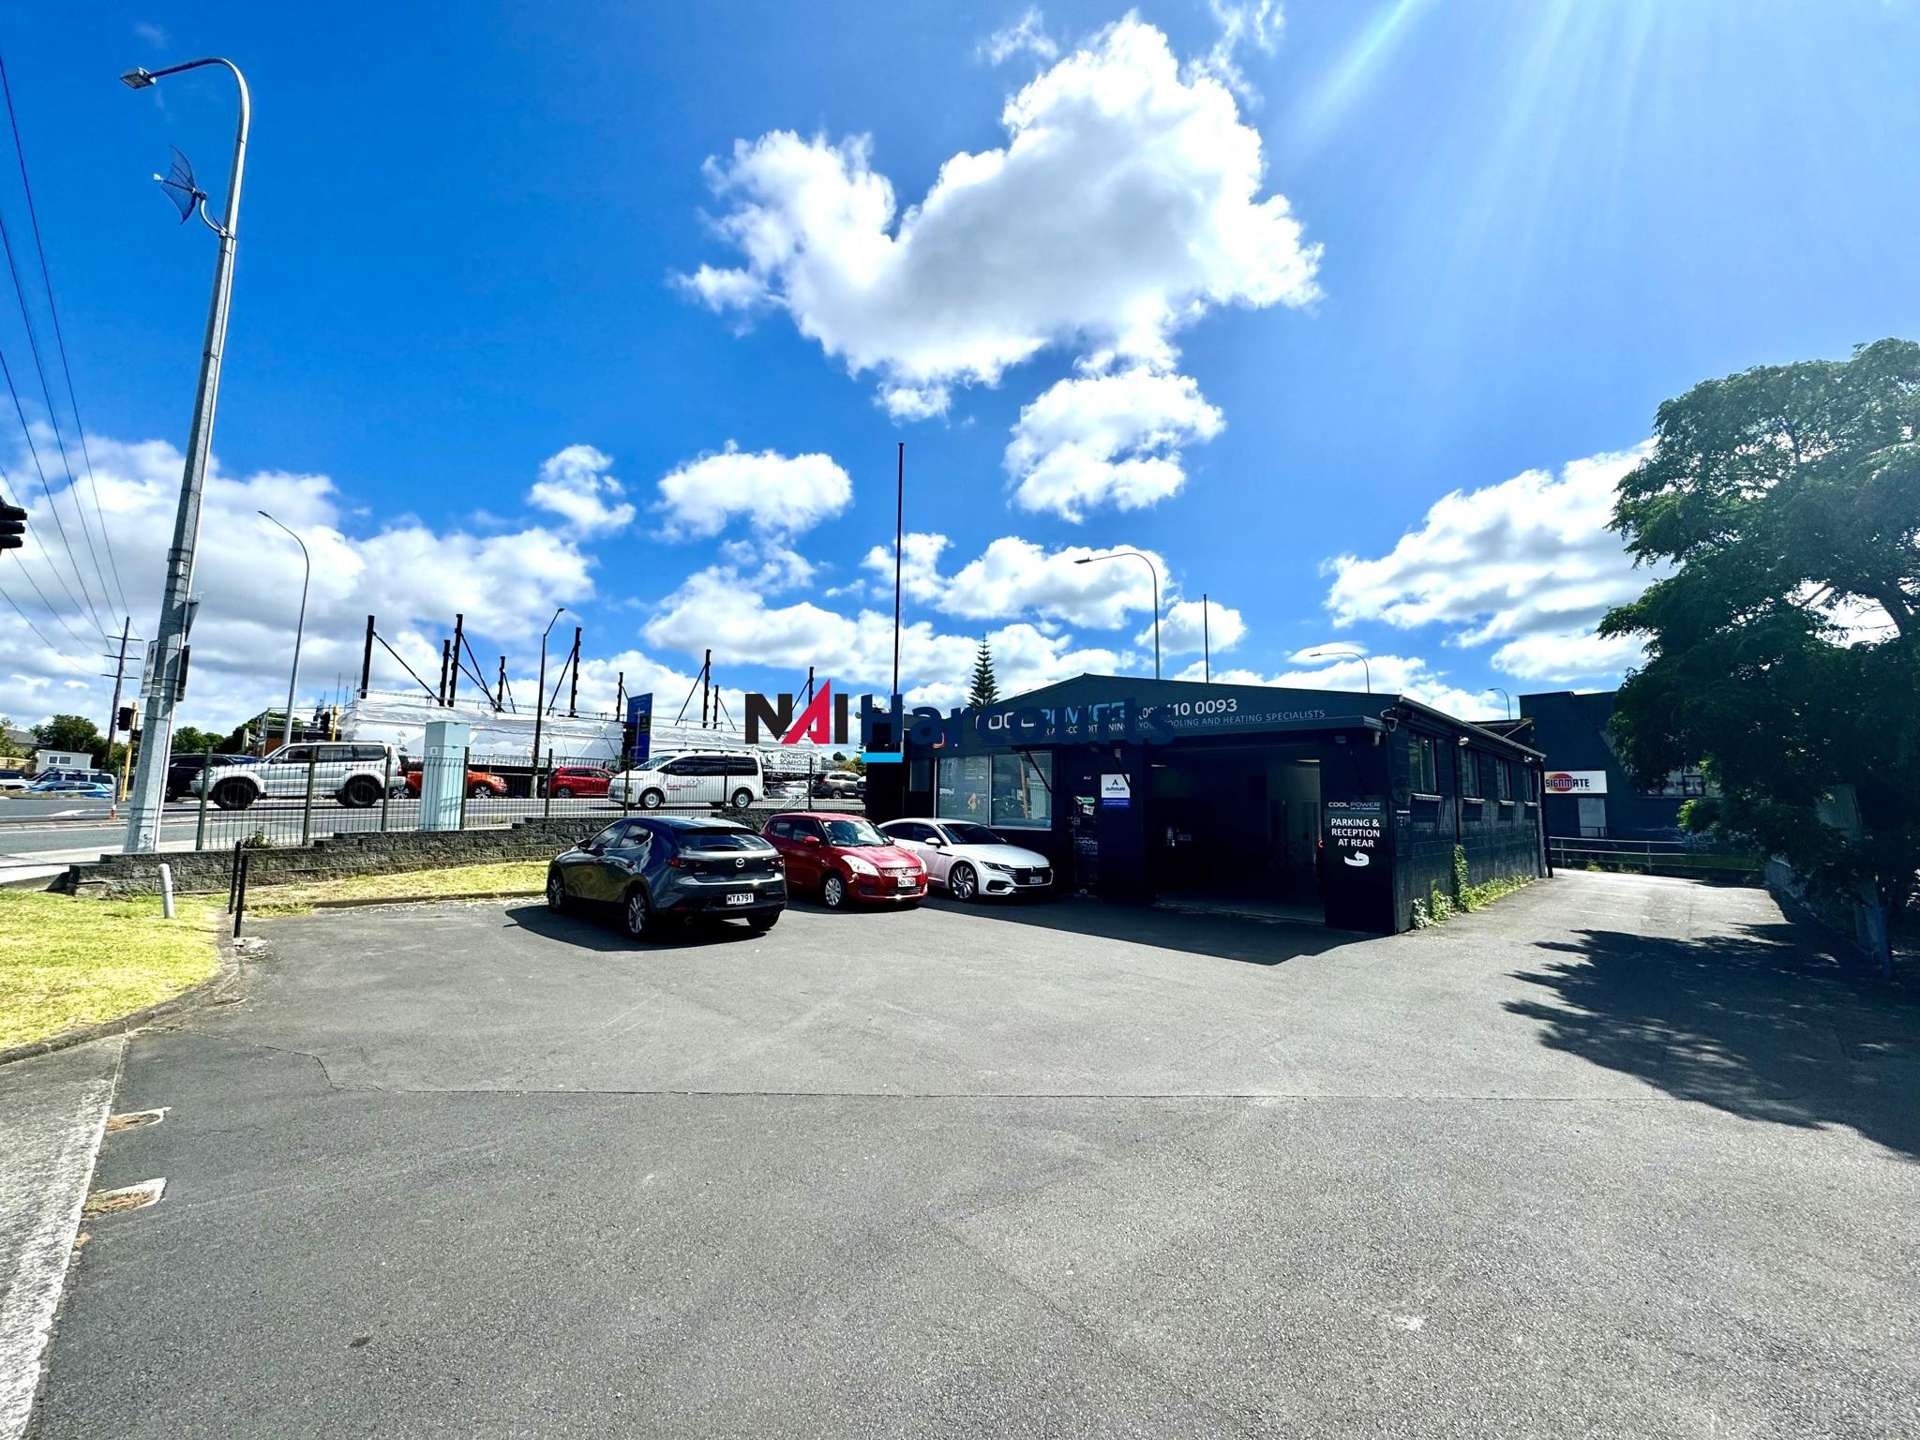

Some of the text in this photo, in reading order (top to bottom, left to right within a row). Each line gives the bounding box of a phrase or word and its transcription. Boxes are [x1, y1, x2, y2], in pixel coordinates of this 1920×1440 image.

[1166, 703, 1190, 716] 10
[1195, 699, 1237, 715] 0093
[1201, 717, 1220, 727] AND
[1223, 713, 1263, 726] HEATING
[1266, 709, 1326, 721] SPECIALISTS
[1545, 778, 1590, 788] SIGNMATE
[1331, 818, 1380, 827] PARKING &
[1331, 828, 1380, 838] RECEPTION
[1338, 838, 1374, 848] AT REAR
[727, 894, 753, 904] MTA791
